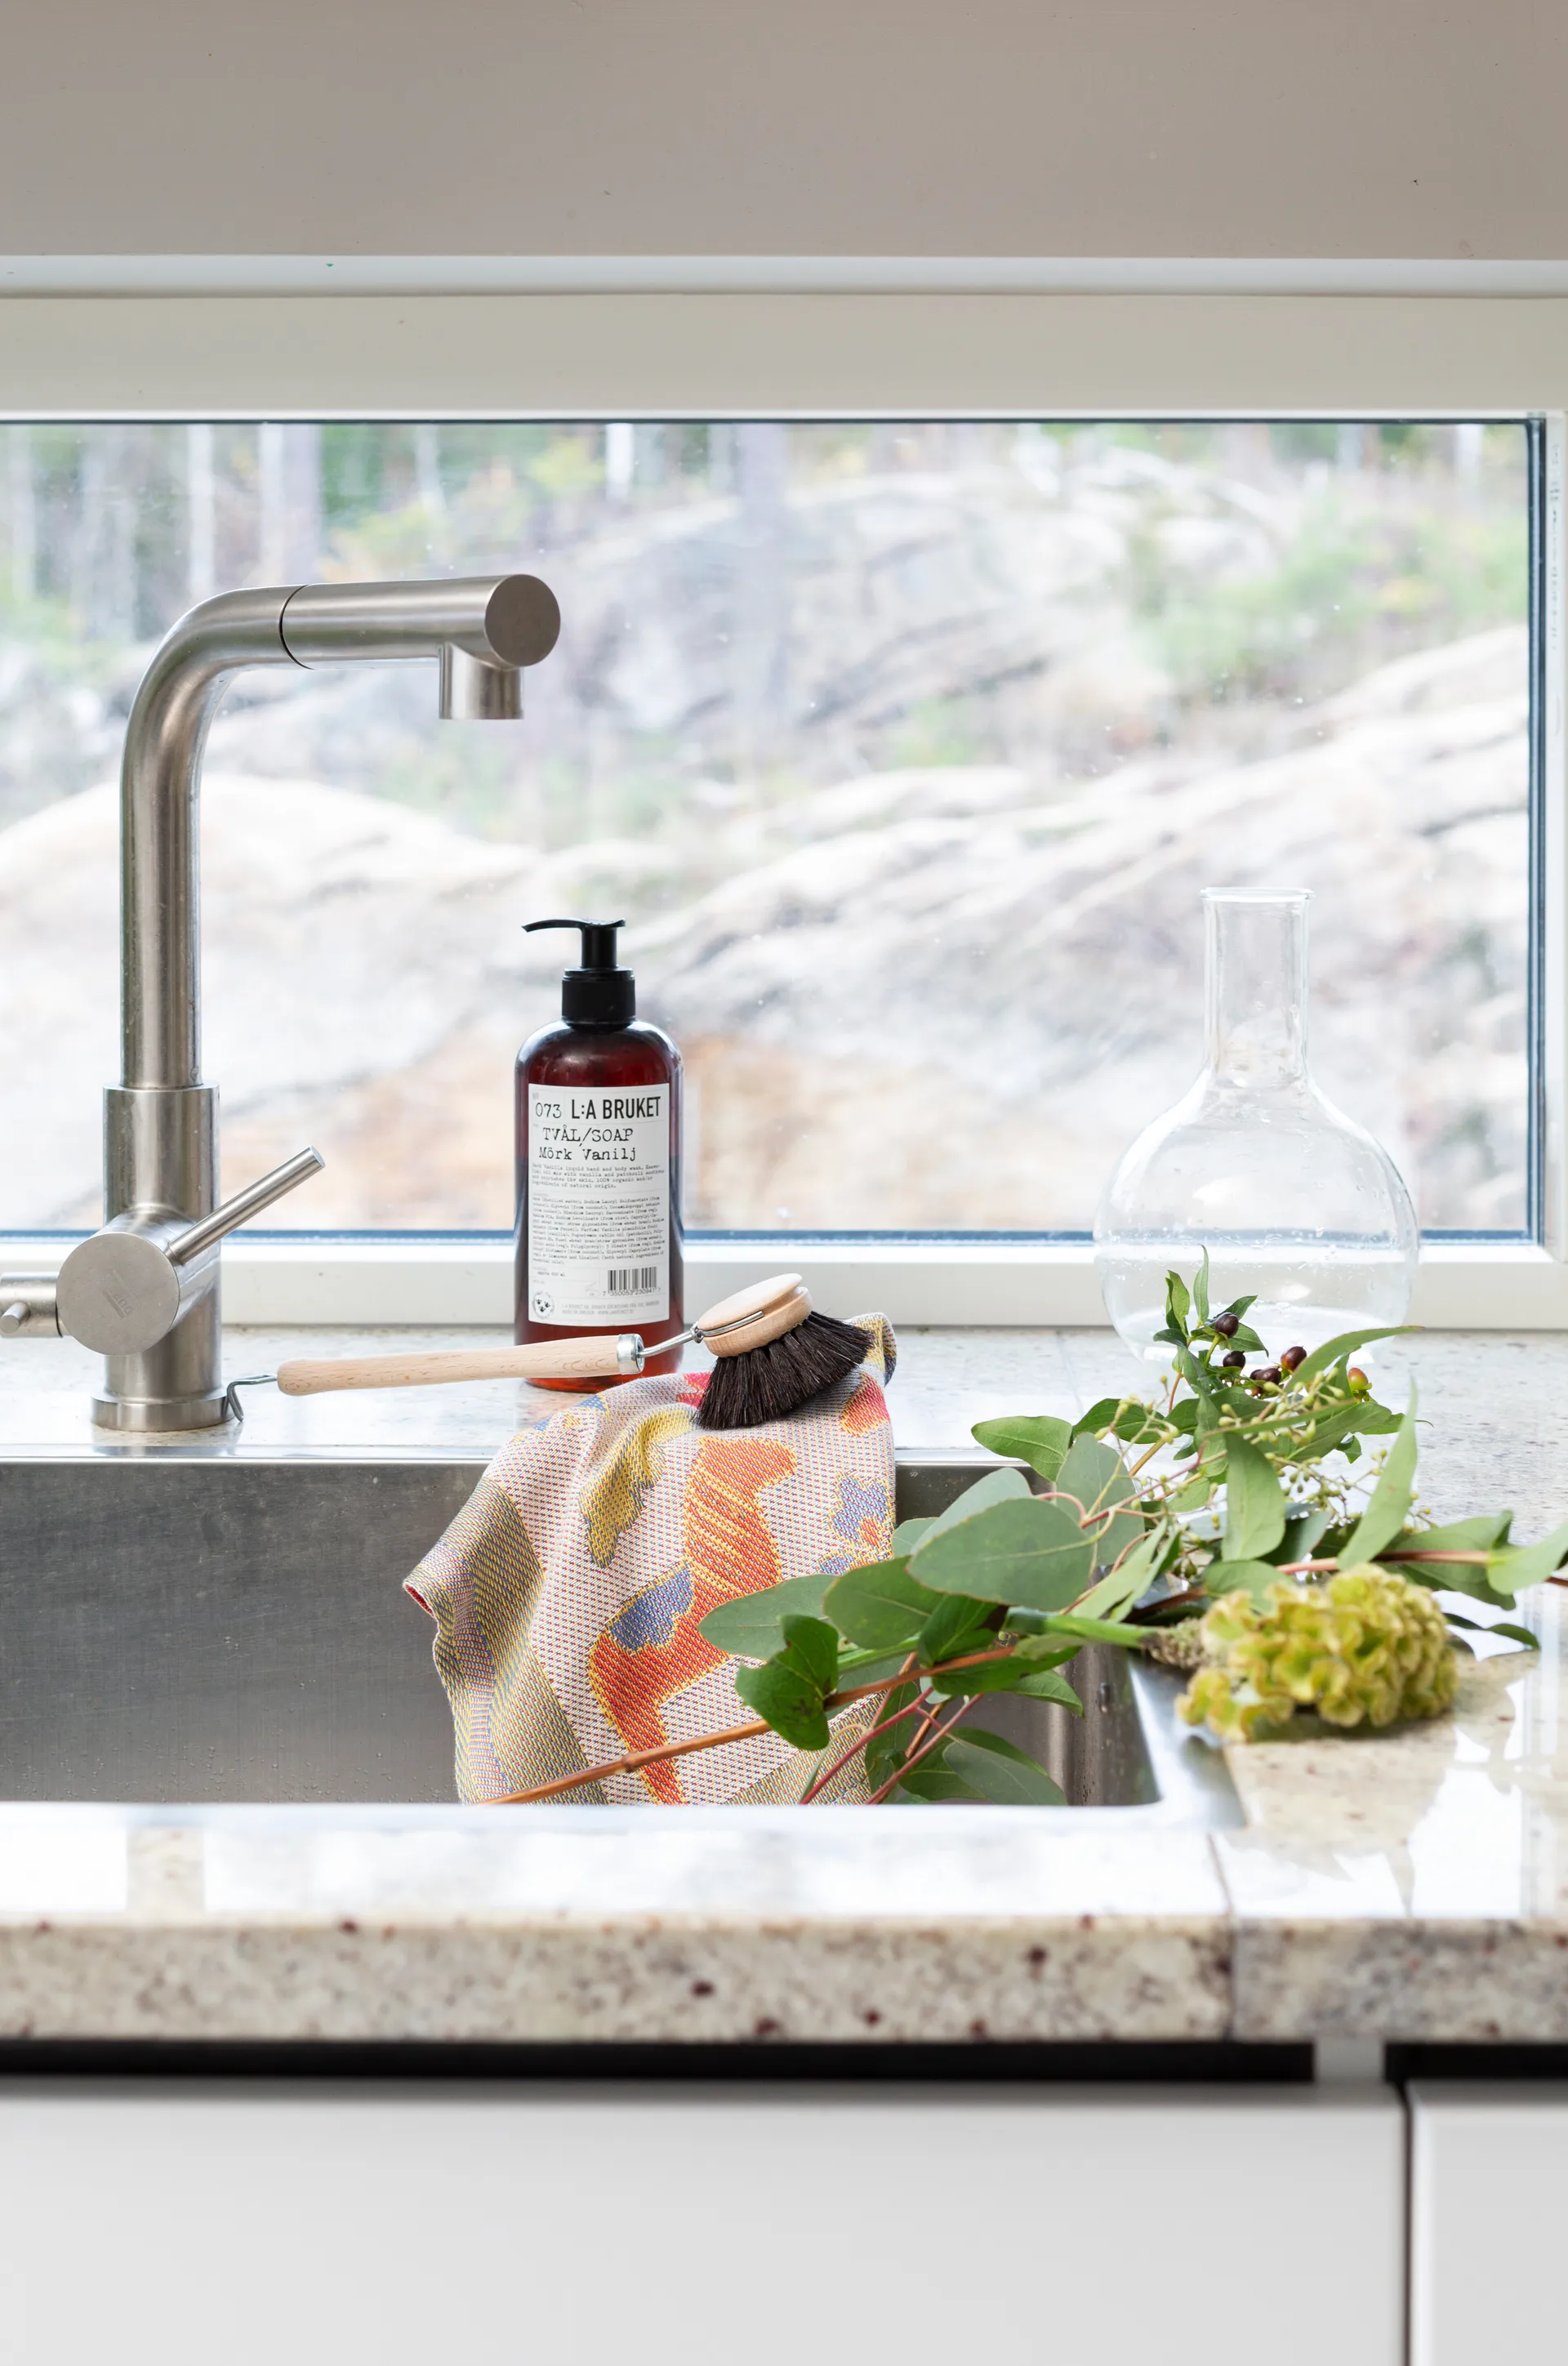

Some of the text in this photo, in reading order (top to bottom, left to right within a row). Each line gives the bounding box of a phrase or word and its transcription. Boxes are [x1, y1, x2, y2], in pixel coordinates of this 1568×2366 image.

[536, 1096, 661, 1119] 073 L:A BRUKET
[543, 1125, 633, 1147] TVÅL/SOAP
[539, 1147, 635, 1161] Mörk Vanilj
